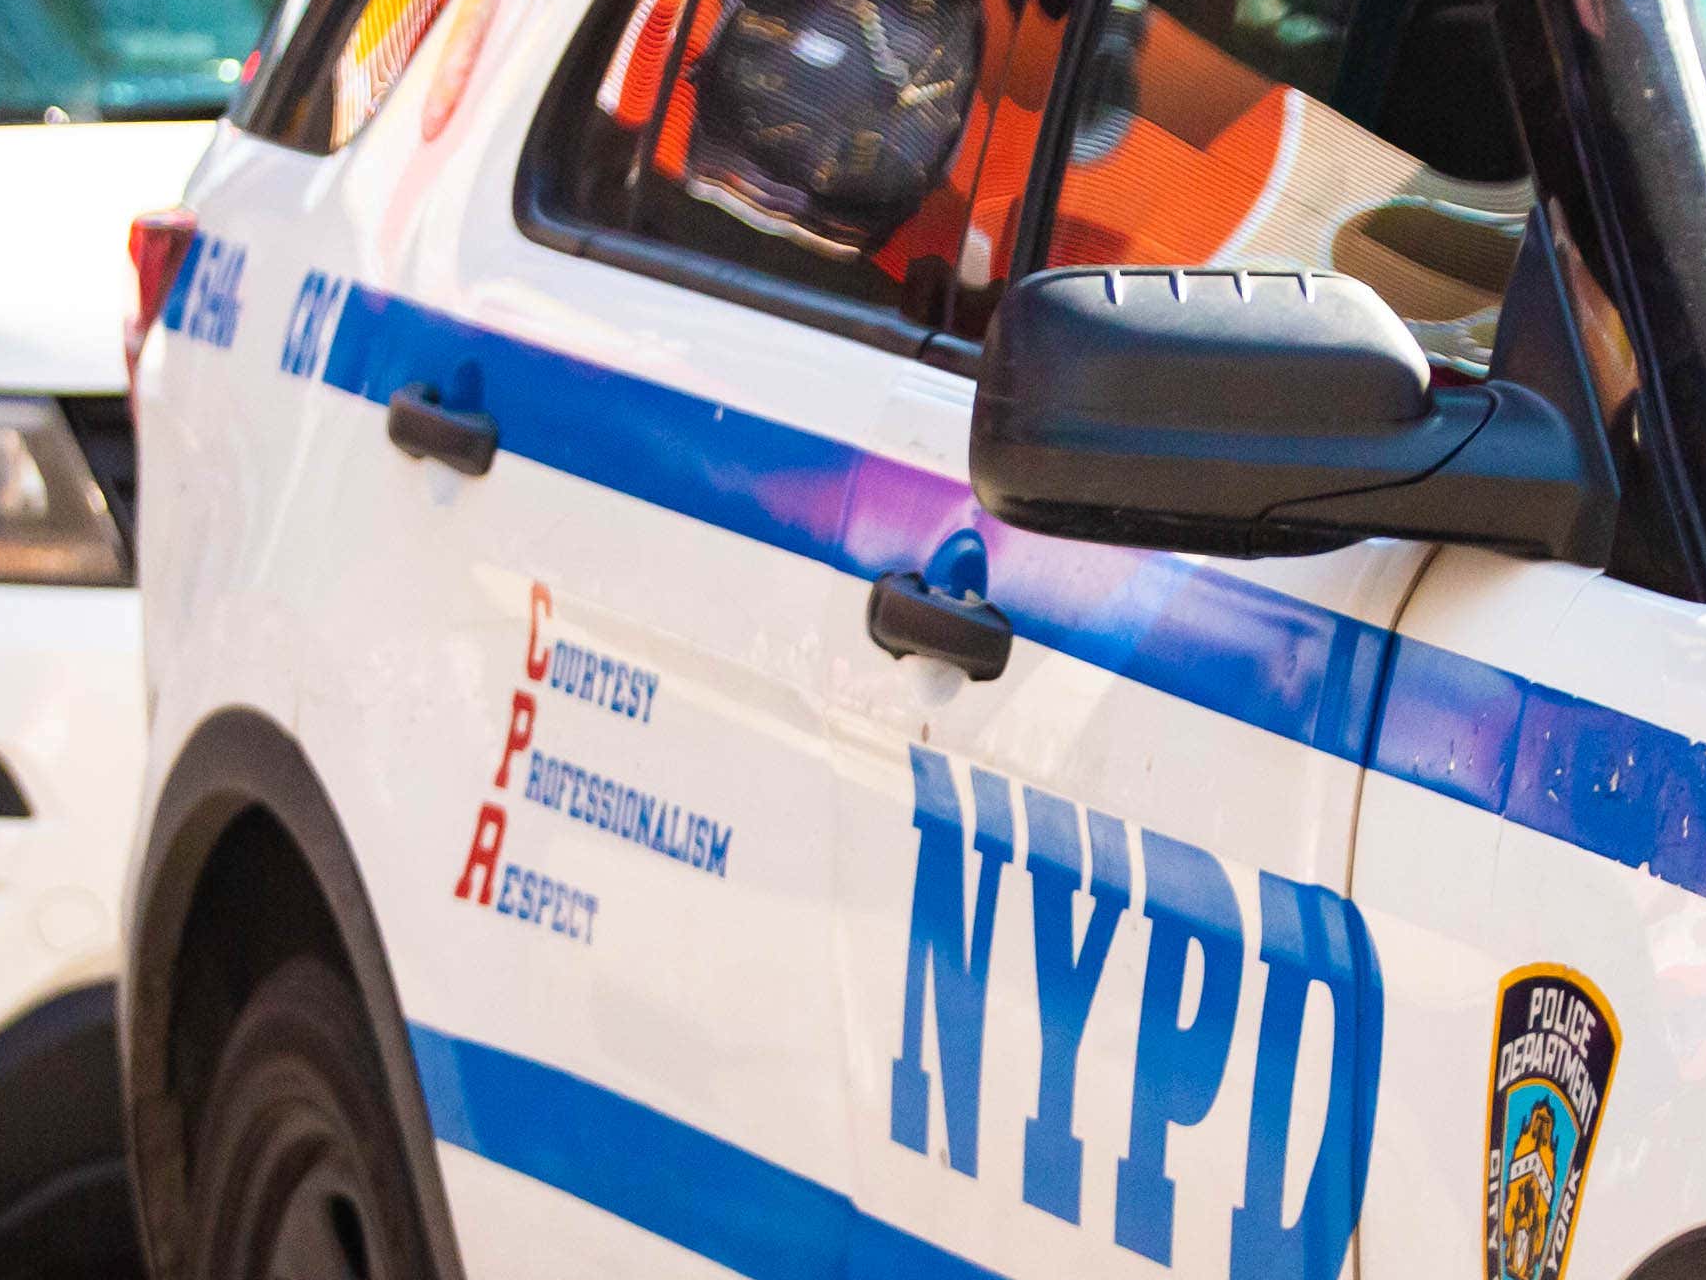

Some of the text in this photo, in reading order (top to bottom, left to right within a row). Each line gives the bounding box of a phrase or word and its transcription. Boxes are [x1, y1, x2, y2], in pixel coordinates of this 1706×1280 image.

[526, 581, 660, 723] COURTESY
[493, 689, 733, 878] PROFESSIONALISM
[454, 801, 600, 945] RESPECT
[1528, 986, 1597, 1060] POLICE
[1497, 1032, 1598, 1137] DEPARTMENT
[1488, 1149, 1502, 1250] CITY
[1546, 1168, 1582, 1272] YORK
